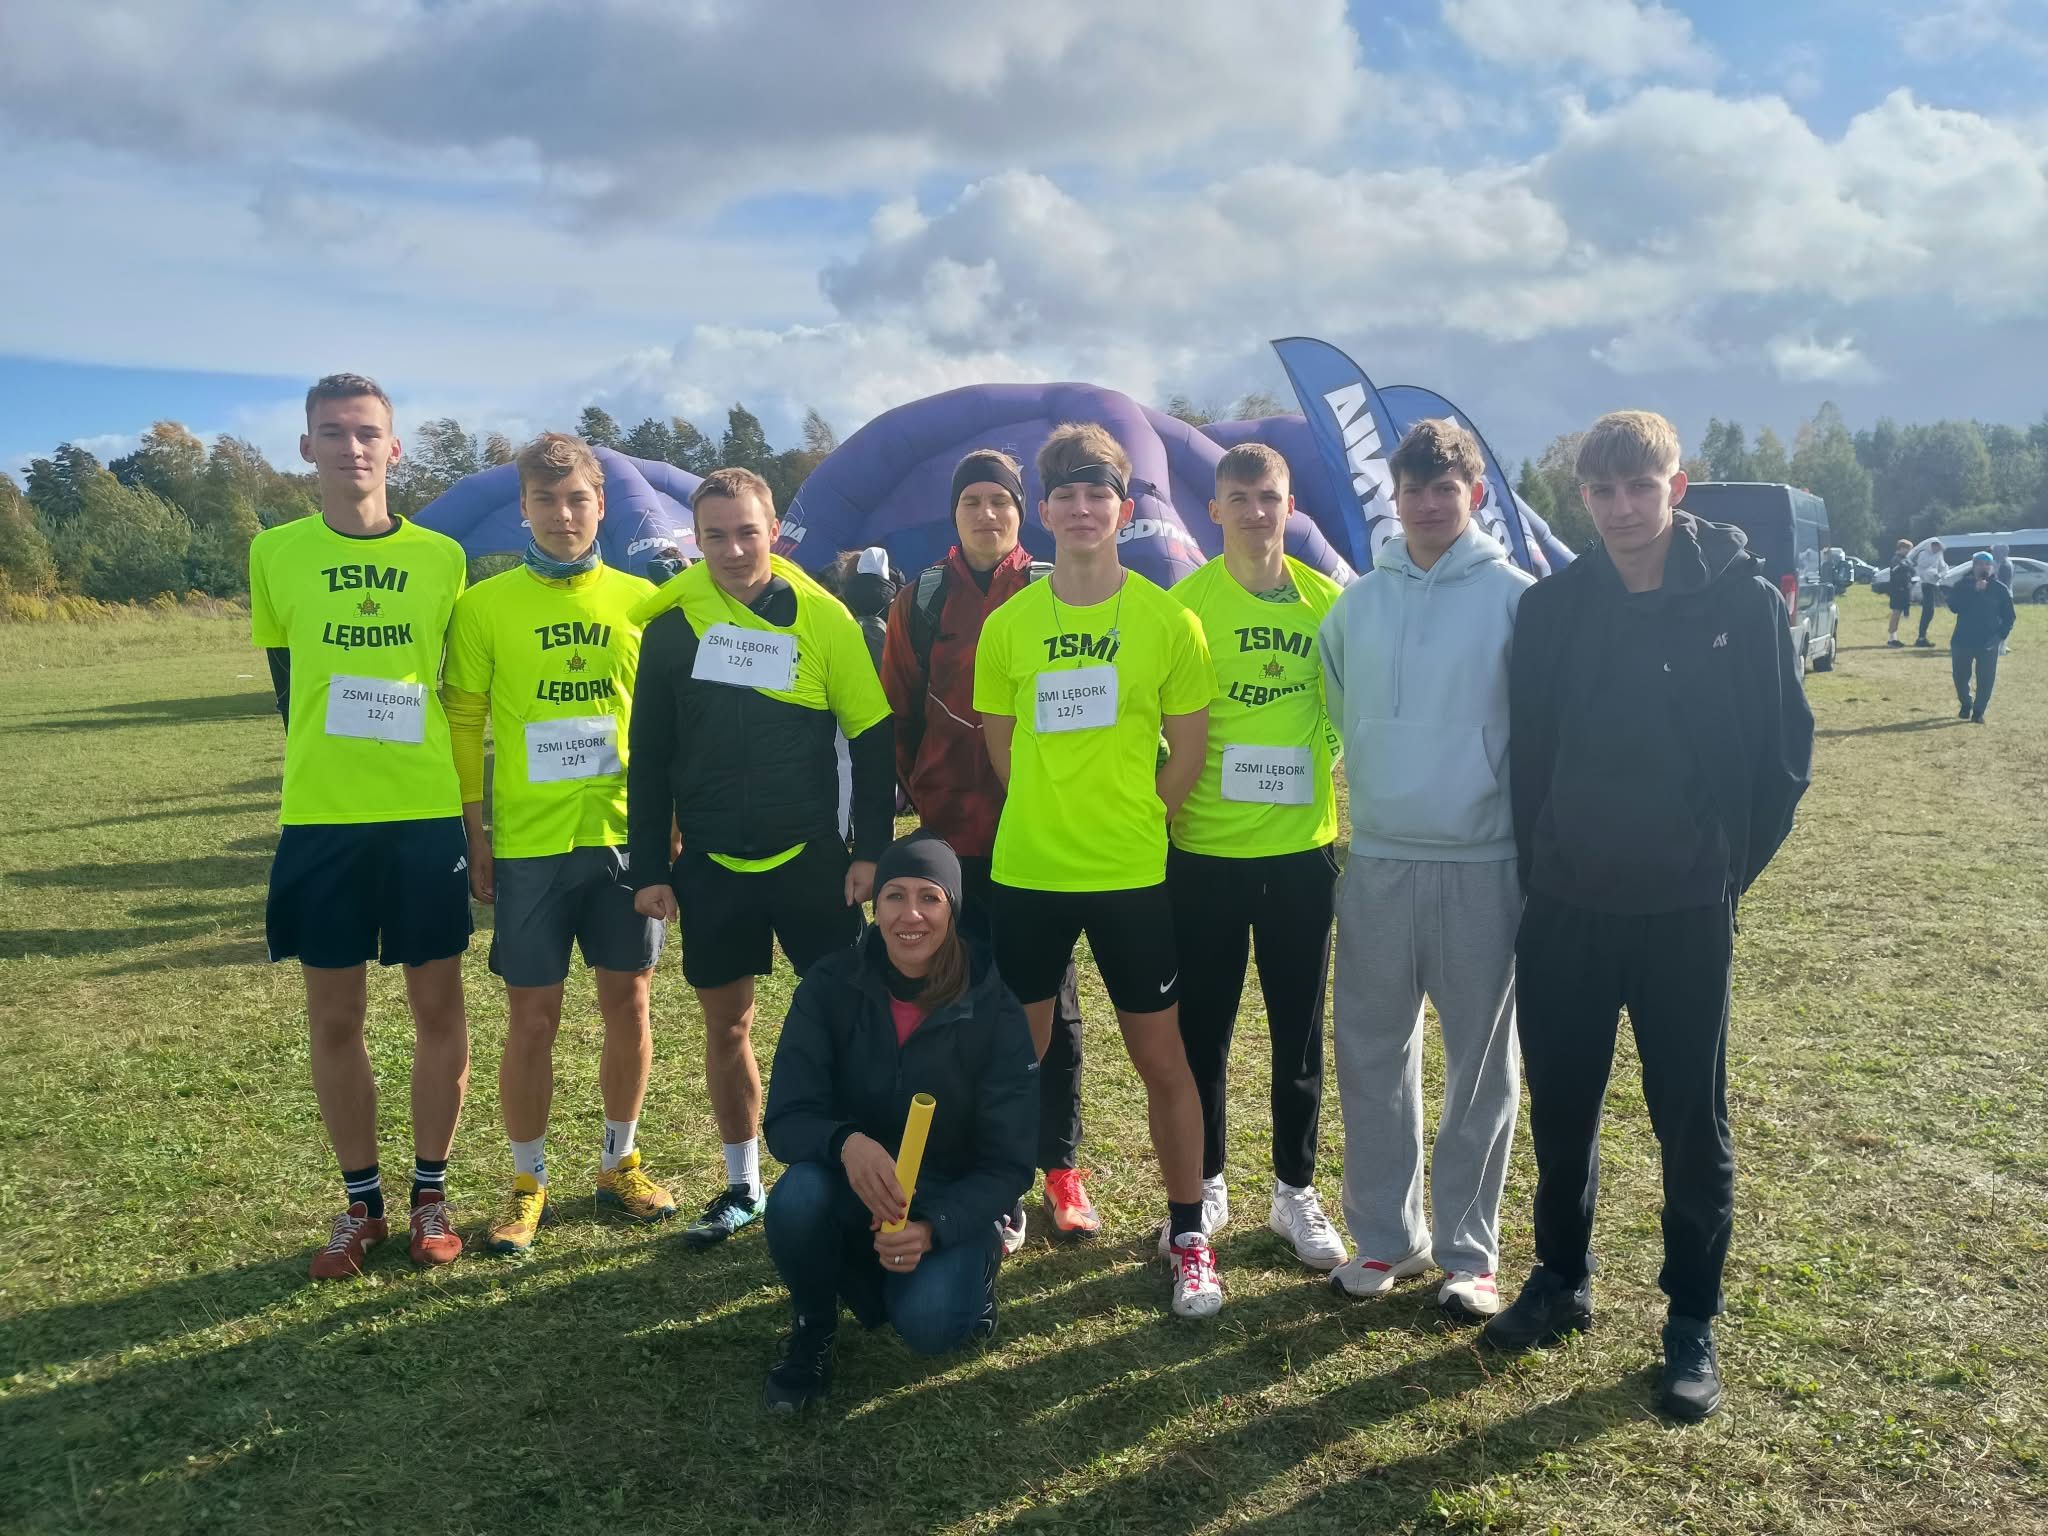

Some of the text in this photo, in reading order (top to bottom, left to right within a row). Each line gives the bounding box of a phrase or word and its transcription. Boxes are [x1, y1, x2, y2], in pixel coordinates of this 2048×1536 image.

[321, 565, 408, 592] ZSMI
[322, 622, 413, 650] LĘBORK
[535, 621, 611, 650] ZSMI
[1234, 627, 1313, 658] ZSMI
[708, 635, 779, 656] ZSMI LĘBORK
[1043, 633, 1121, 663] ZSMI
[728, 655, 753, 668] 12/6
[342, 688, 420, 707] ZSMI LĘBORK
[536, 678, 617, 705] LĘBORK
[1062, 685, 1107, 700] LĘBORK
[367, 708, 394, 721] 12/4
[1057, 704, 1084, 718] 12/5
[537, 736, 606, 754] ZSMI LĘBORK
[562, 754, 586, 767] 12/1
[1234, 762, 1305, 777] ZSMI LĘBORK
[1258, 779, 1284, 791] 12/3
